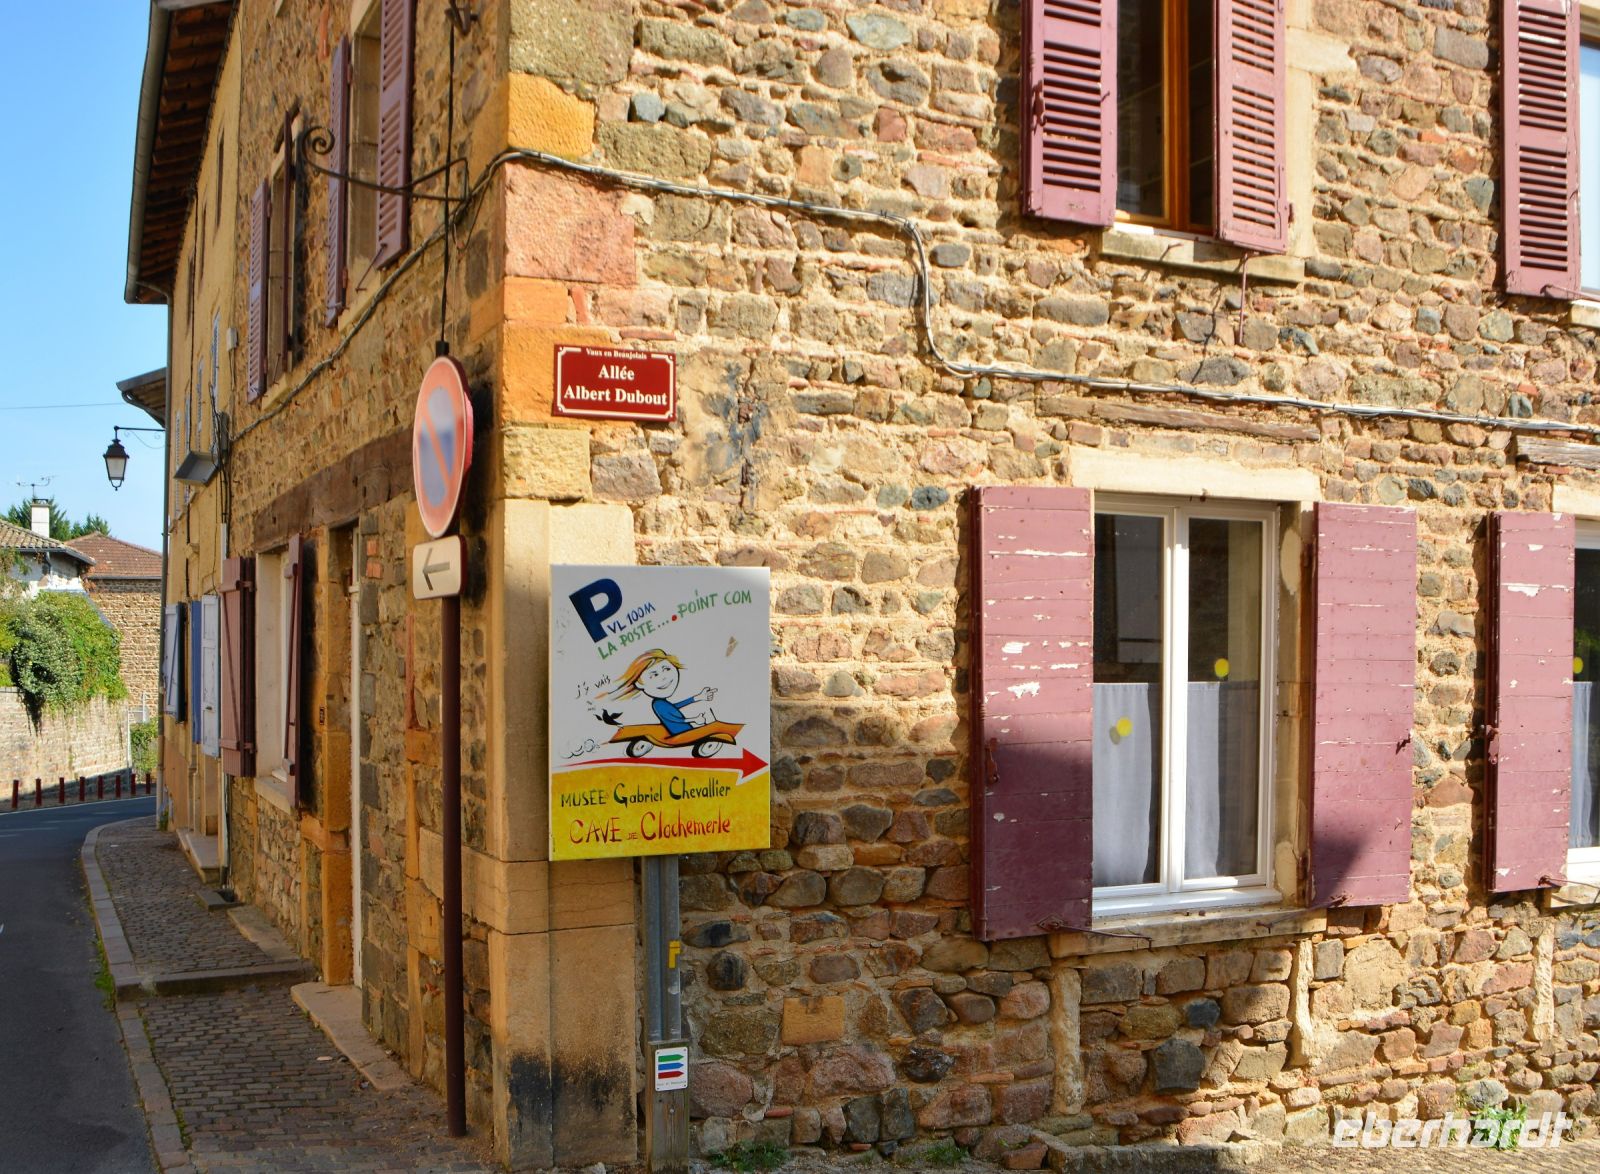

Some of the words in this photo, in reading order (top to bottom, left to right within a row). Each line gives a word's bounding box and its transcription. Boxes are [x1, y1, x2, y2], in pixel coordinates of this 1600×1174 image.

[585, 347, 603, 356] Vaux
[613, 349, 647, 360] Beaujolais
[598, 364, 635, 380] Allée
[563, 384, 611, 402] Albert
[615, 388, 668, 406] Dubout
[597, 641, 618, 660] LA
[723, 589, 752, 606] COM
[607, 620, 627, 633] VL
[613, 782, 663, 808] Gabriel
[669, 776, 731, 801] Chevallier
[569, 816, 622, 844] CAVE
[640, 806, 731, 841] Clochemerle
